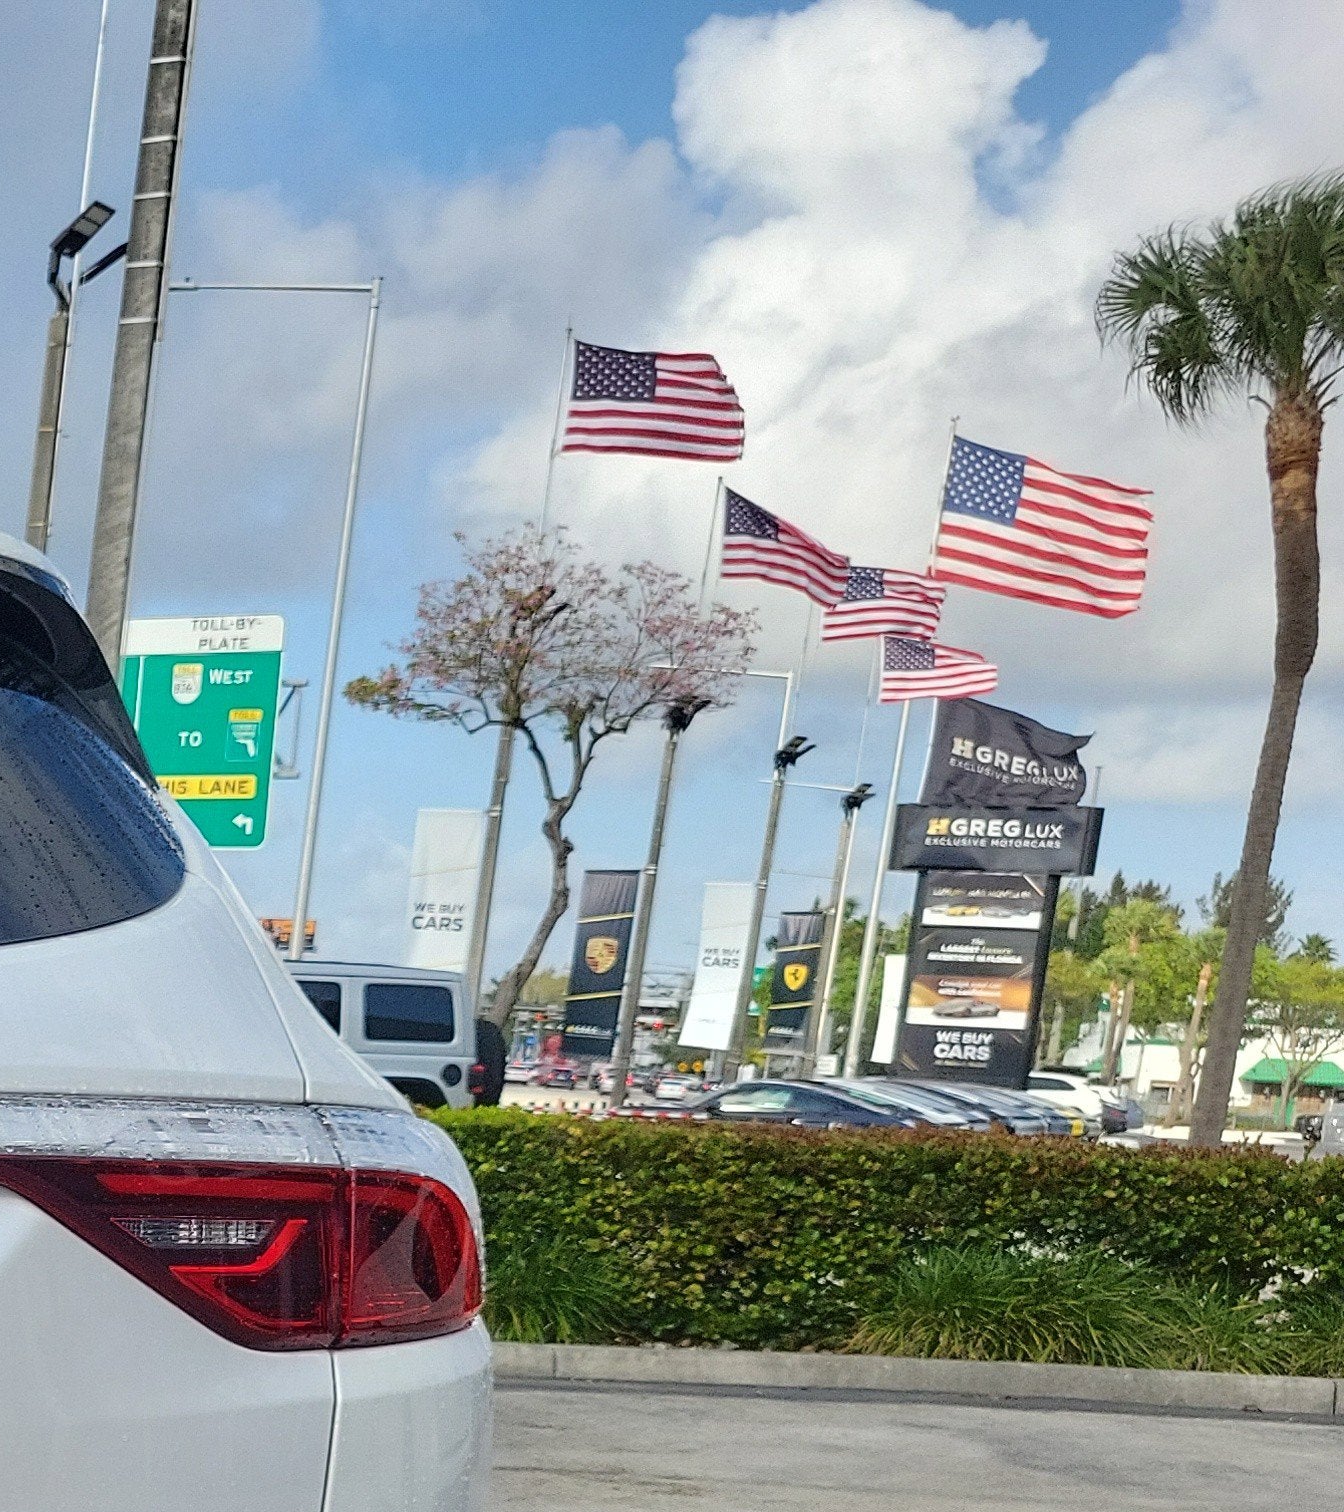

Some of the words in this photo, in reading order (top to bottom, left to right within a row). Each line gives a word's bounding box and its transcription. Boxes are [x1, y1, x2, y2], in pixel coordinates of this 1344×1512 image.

[198, 637, 250, 650] PLATE
[209, 669, 253, 684] WEST
[178, 731, 202, 747] TO
[949, 758, 1010, 784] EXCLUSIVE
[199, 780, 249, 795] LANE
[1024, 823, 1063, 839] LUX
[924, 837, 987, 847] EXCLUSIVE
[990, 838, 1062, 849] MOTORCARS
[413, 902, 435, 913] WE
[438, 904, 465, 914] BUY
[412, 916, 463, 931] CARS
[702, 956, 739, 968] CARS
[936, 1030, 961, 1043] WE
[962, 1032, 994, 1045] BUY
[934, 1043, 991, 1061] CARS
